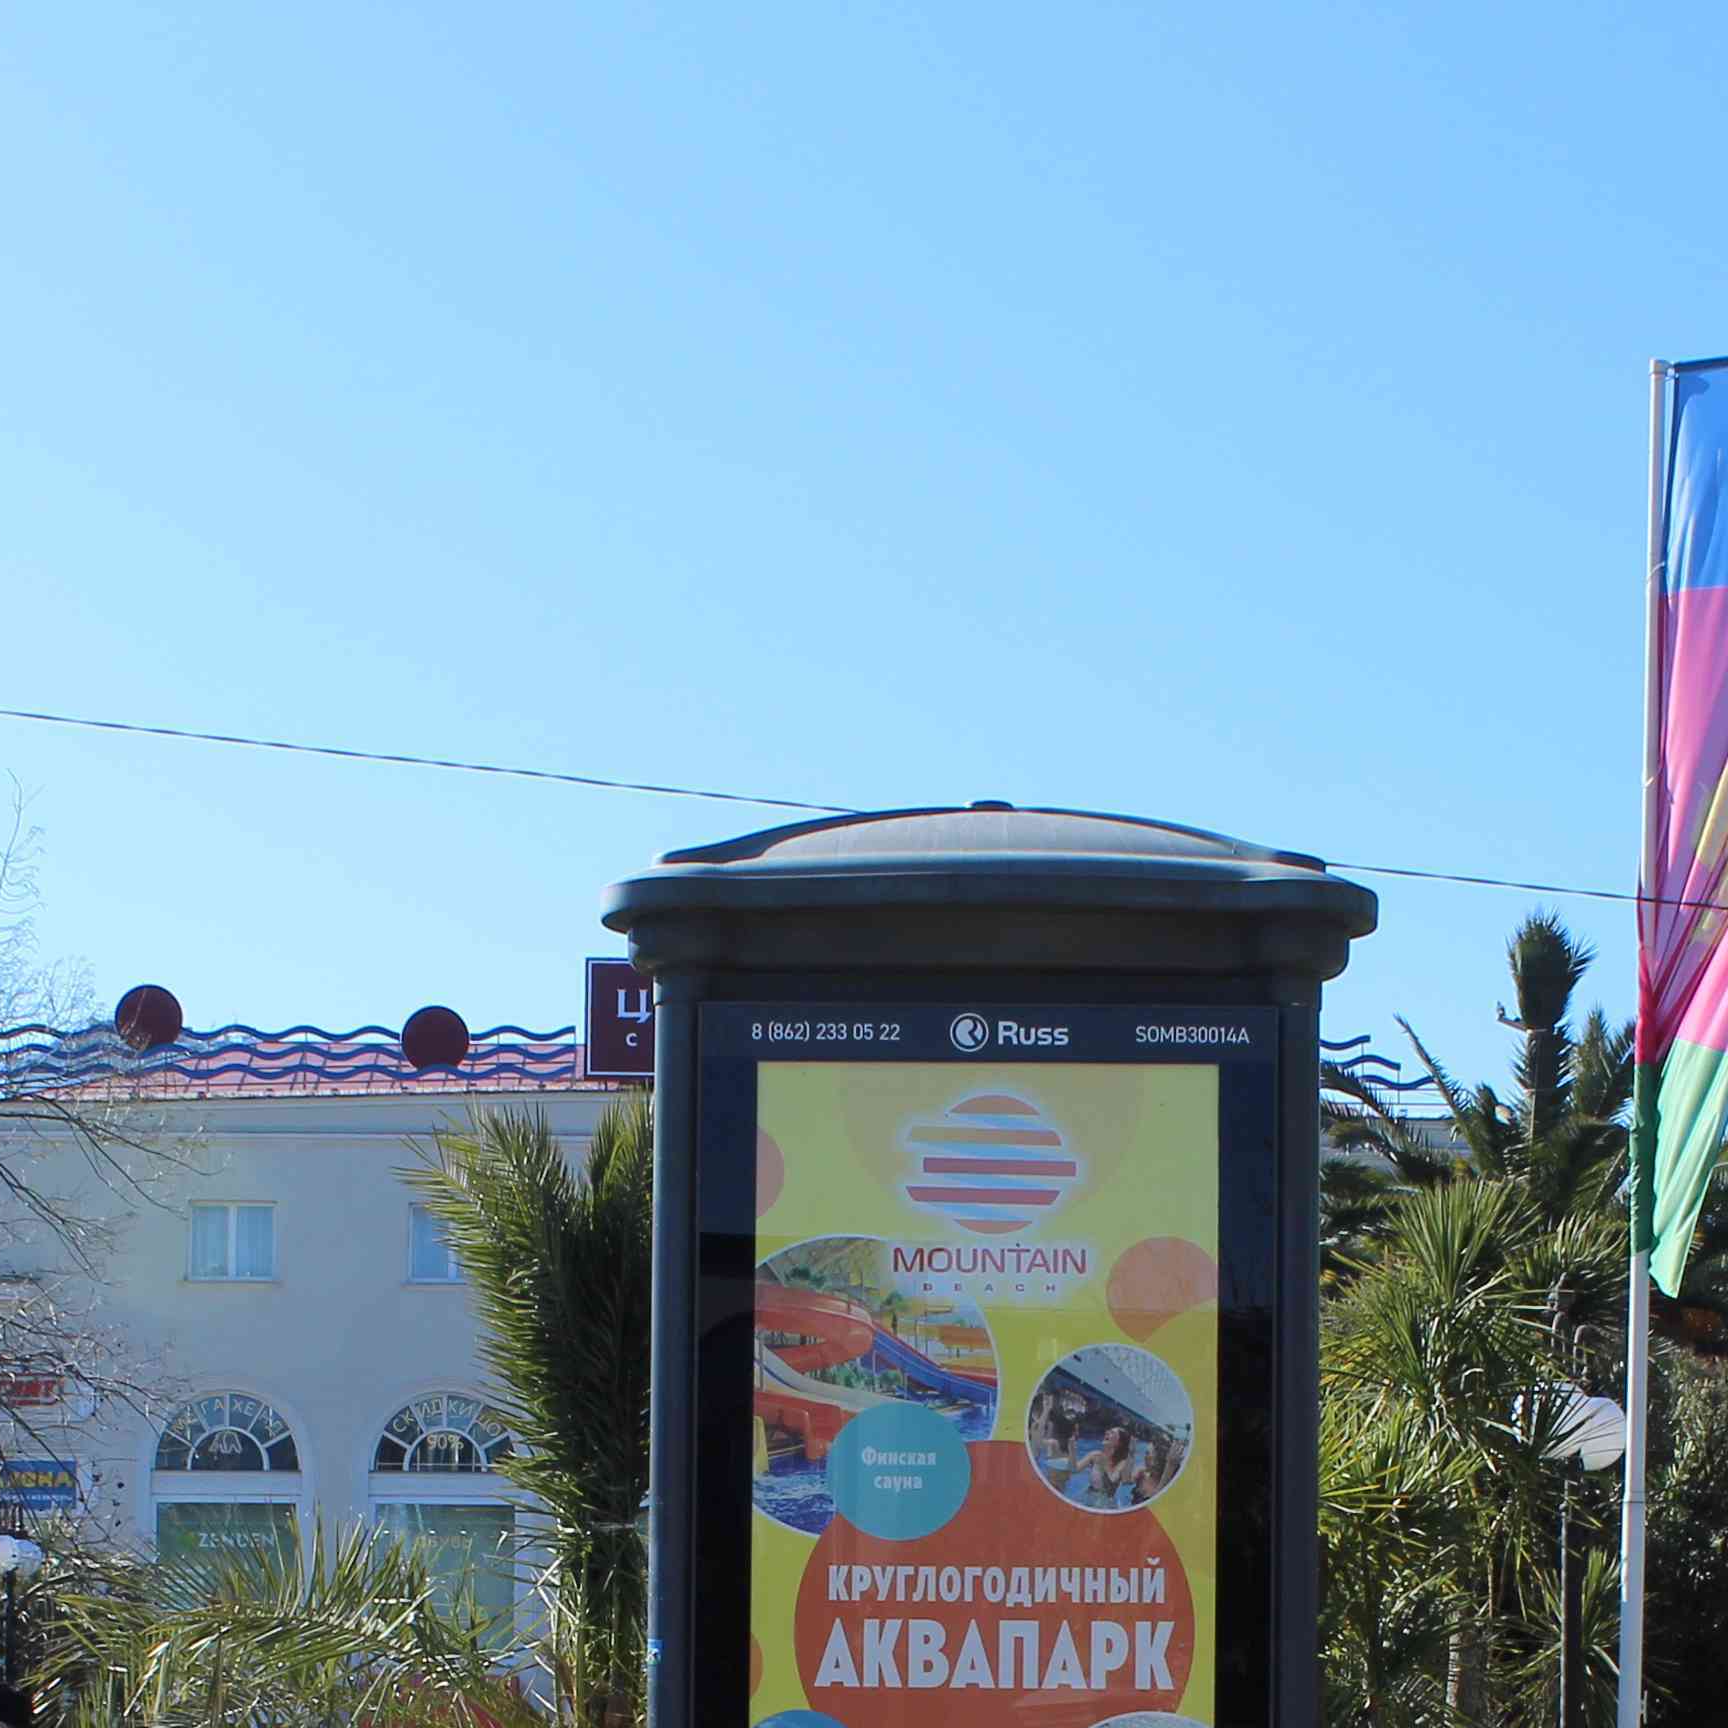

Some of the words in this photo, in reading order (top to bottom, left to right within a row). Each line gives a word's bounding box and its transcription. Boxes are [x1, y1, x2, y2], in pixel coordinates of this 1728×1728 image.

[752, 1023, 762, 1040] 8
[768, 1020, 810, 1042] (862)
[816, 1023, 847, 1040] 233
[853, 1023, 873, 1040] 05
[879, 1023, 900, 1040] 22
[998, 1020, 1069, 1045] Russ
[1135, 1026, 1250, 1043] SOMB30014A
[893, 1247, 1087, 1274] MOUNTAIN
[923, 1283, 1056, 1292] BEACH
[426, 1434, 465, 1450] 90%
[862, 1446, 937, 1466] Финская
[874, 1476, 923, 1493] сауна
[827, 1556, 1166, 1608] КРУГЛОГОДИЧНЫЙ
[813, 1617, 1176, 1690] АКВАПАРК
